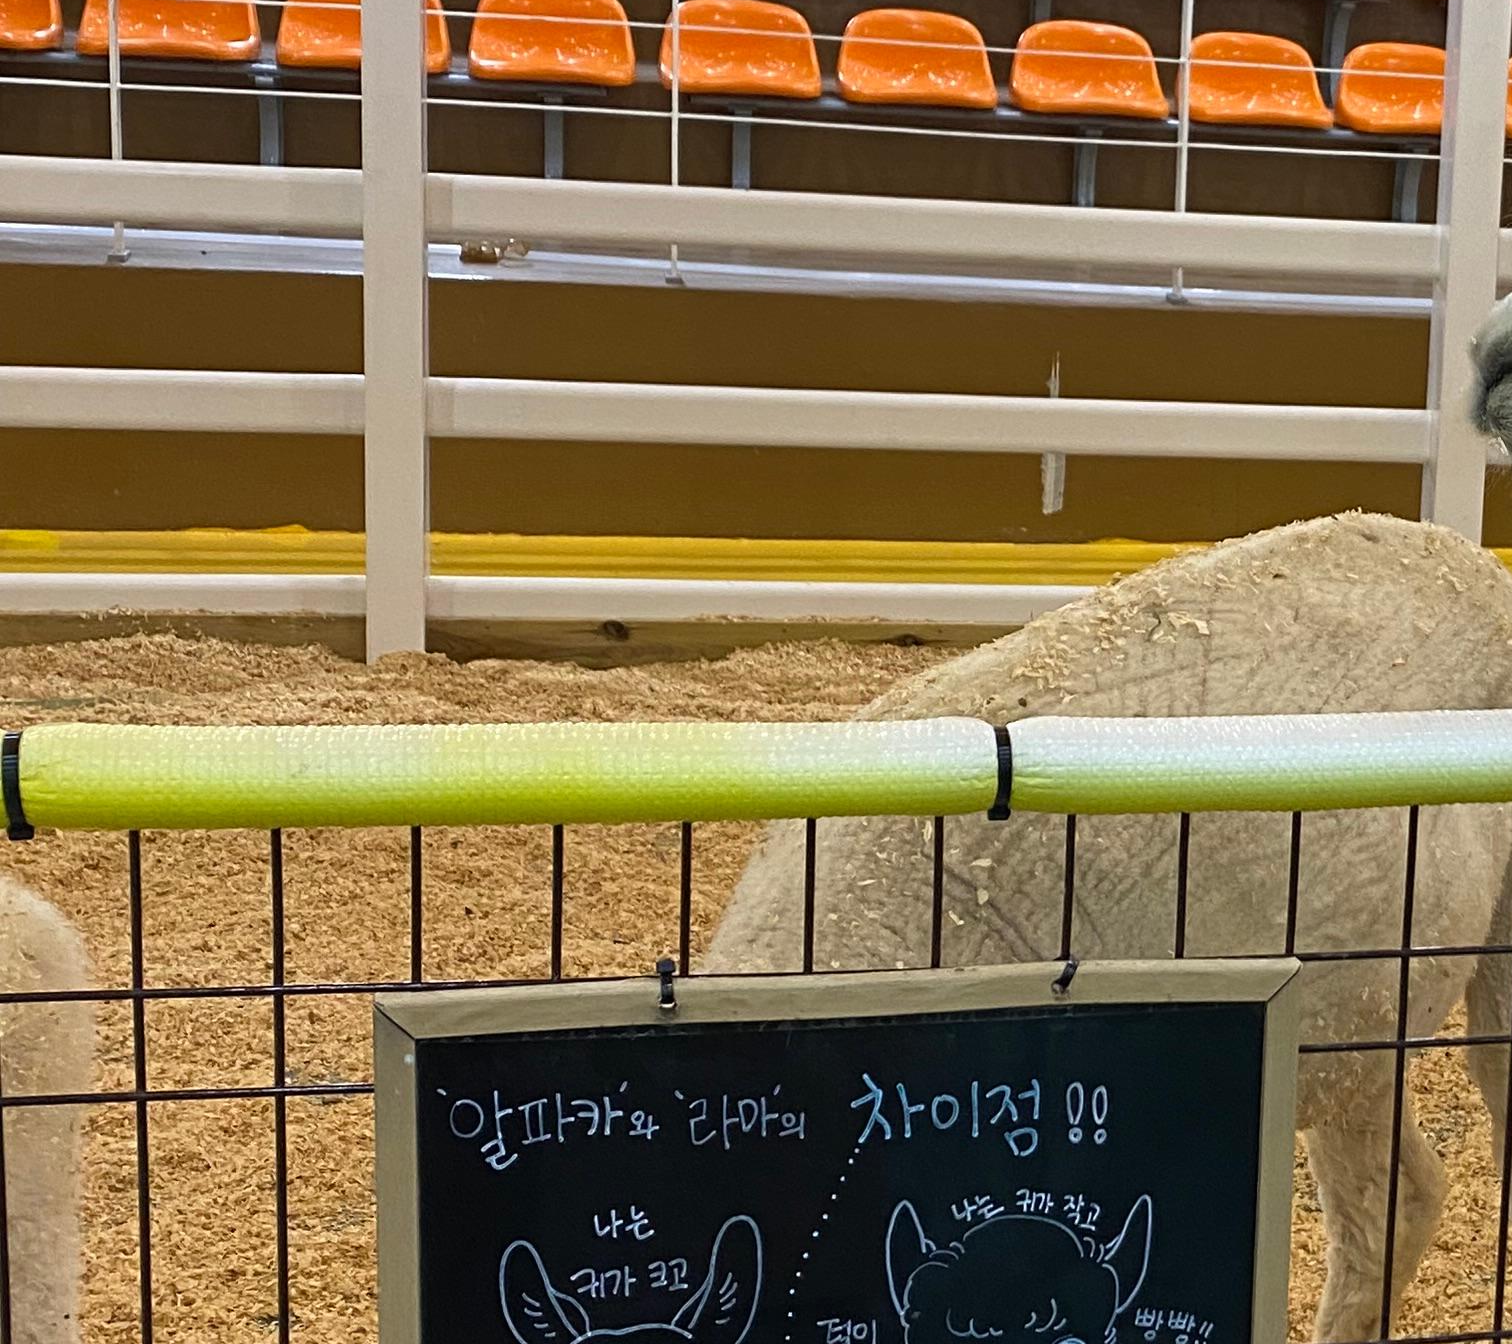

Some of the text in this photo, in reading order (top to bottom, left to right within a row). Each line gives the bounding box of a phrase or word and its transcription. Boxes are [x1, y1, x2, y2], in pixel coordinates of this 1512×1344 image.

[850, 1072, 1041, 1157] 차이점
[593, 1204, 655, 1241] 나는
[951, 1188, 1102, 1232] 나는 귀가 작고
[569, 1257, 689, 1298] 귀가 크고
